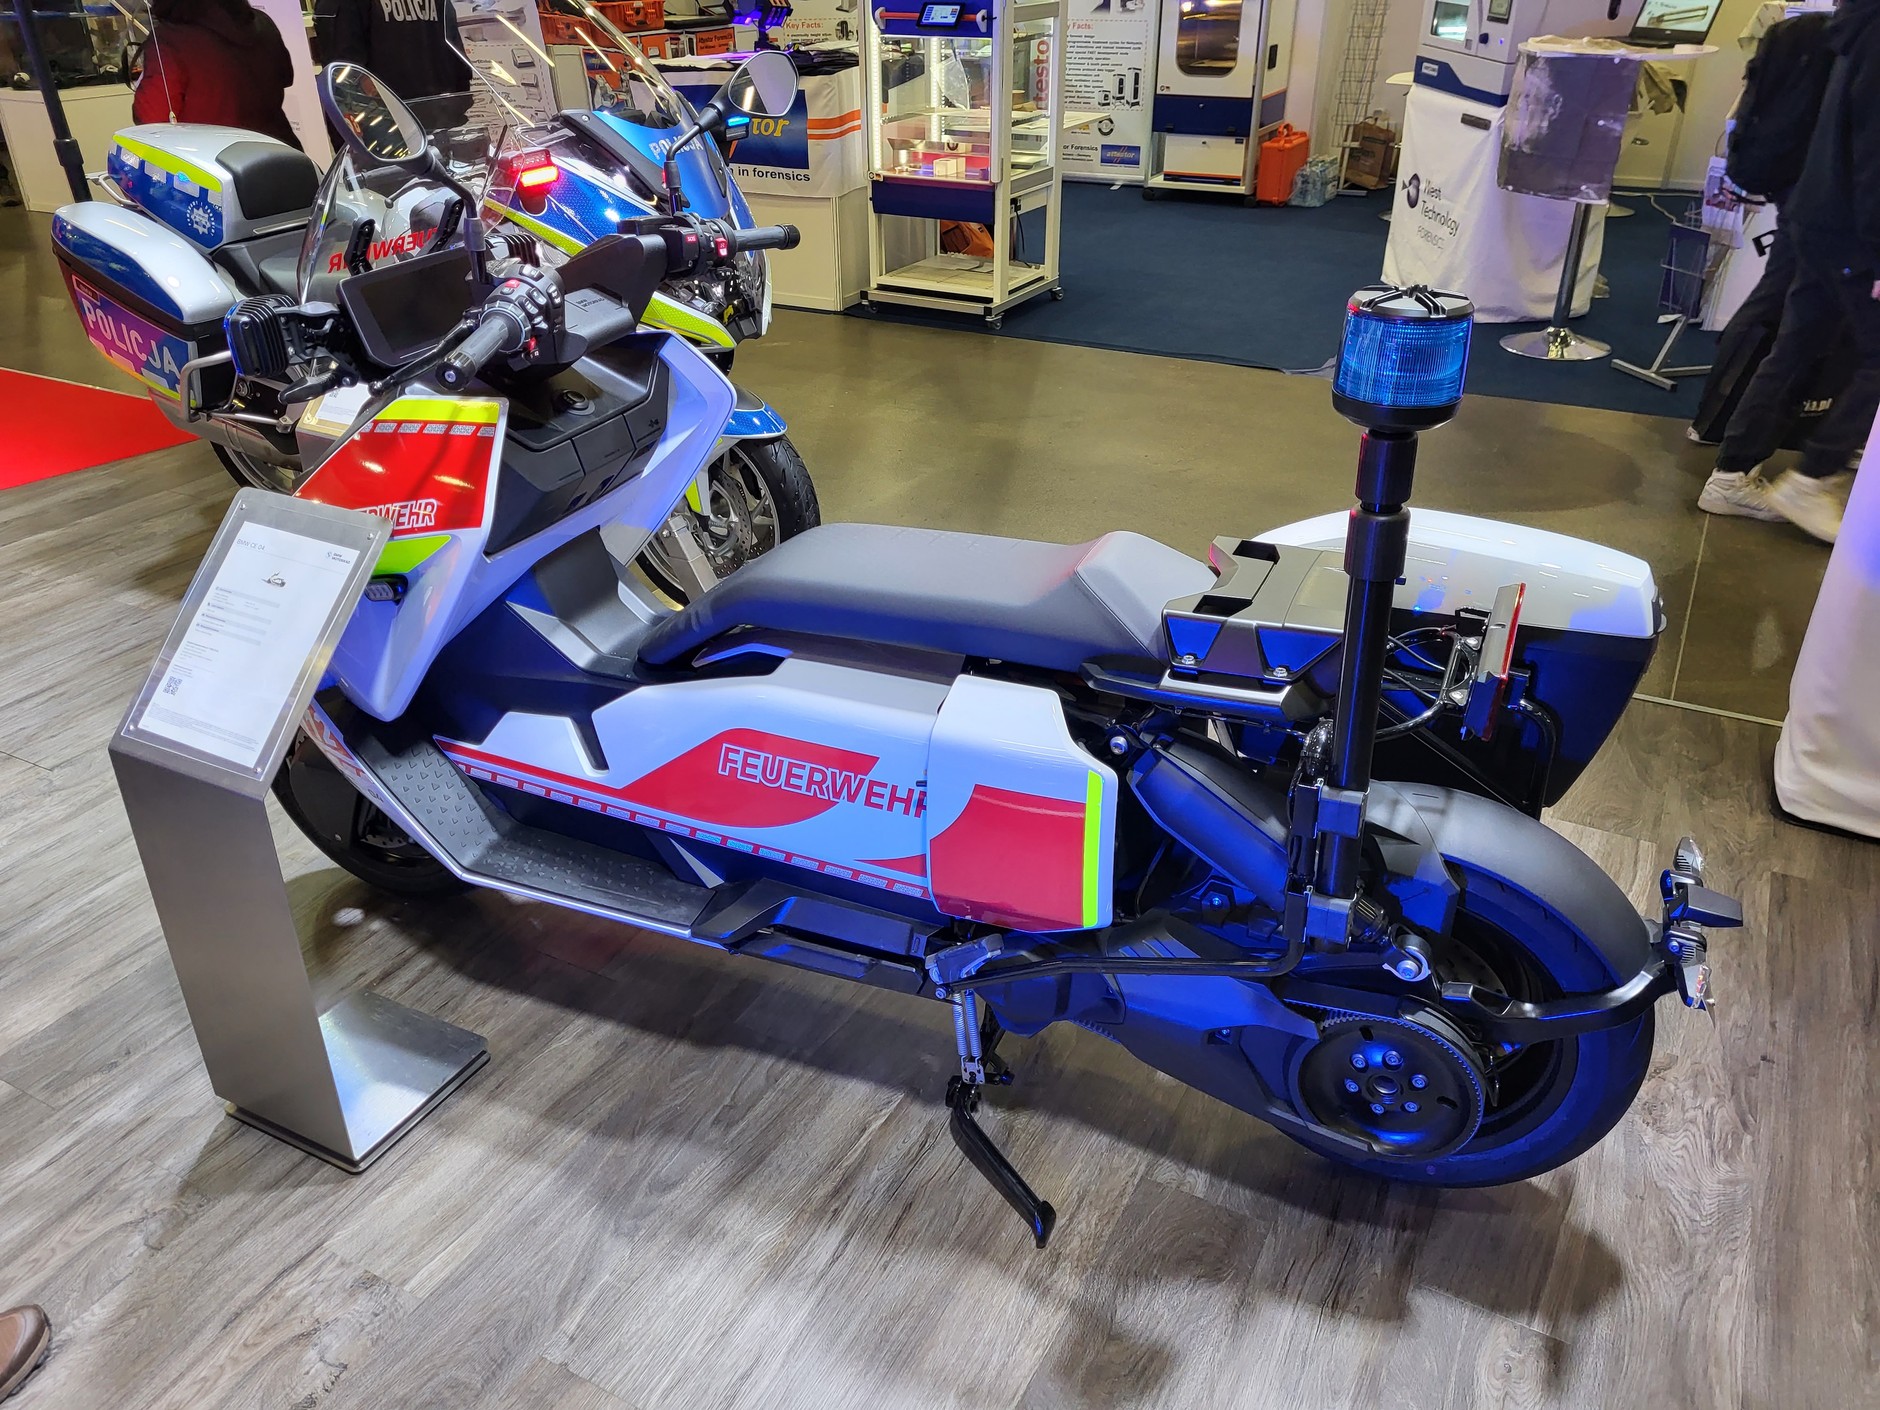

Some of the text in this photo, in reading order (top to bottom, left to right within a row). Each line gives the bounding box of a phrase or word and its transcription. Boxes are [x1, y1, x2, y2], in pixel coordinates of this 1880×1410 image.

[380, 0, 438, 22] POLICJA
[785, 22, 800, 31] Key
[1072, 22, 1094, 30] Facts:
[1033, 40, 1050, 102] testo
[1071, 143, 1098, 151] Forensics
[738, 167, 749, 177] in
[753, 168, 811, 181] forensics
[1420, 200, 1461, 237] Technology
[81, 297, 180, 380] POLICJA
